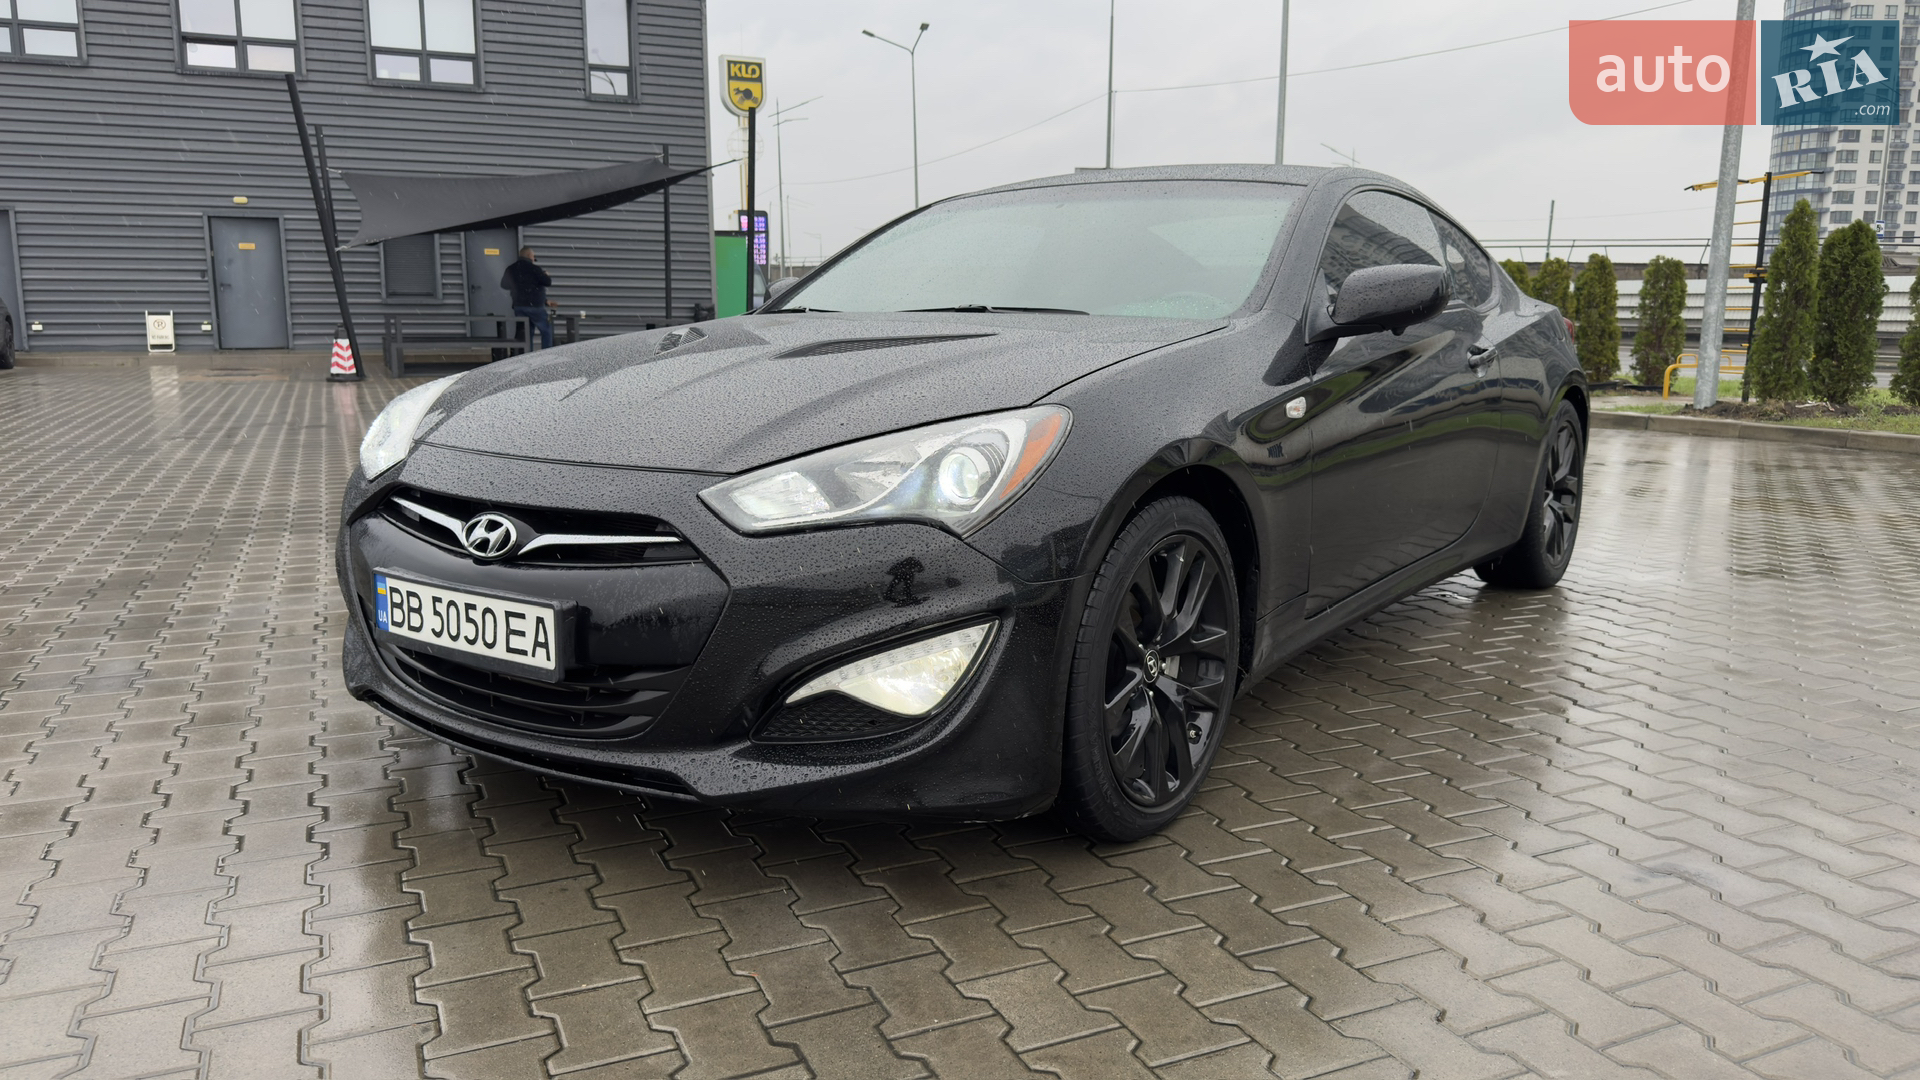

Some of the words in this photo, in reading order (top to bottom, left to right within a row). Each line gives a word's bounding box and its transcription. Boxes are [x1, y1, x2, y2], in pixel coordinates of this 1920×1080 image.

[731, 63, 760, 79] KLO
[377, 610, 388, 624] UA
[389, 585, 424, 633] BB
[431, 595, 497, 649] 5050
[504, 610, 552, 662] EA
